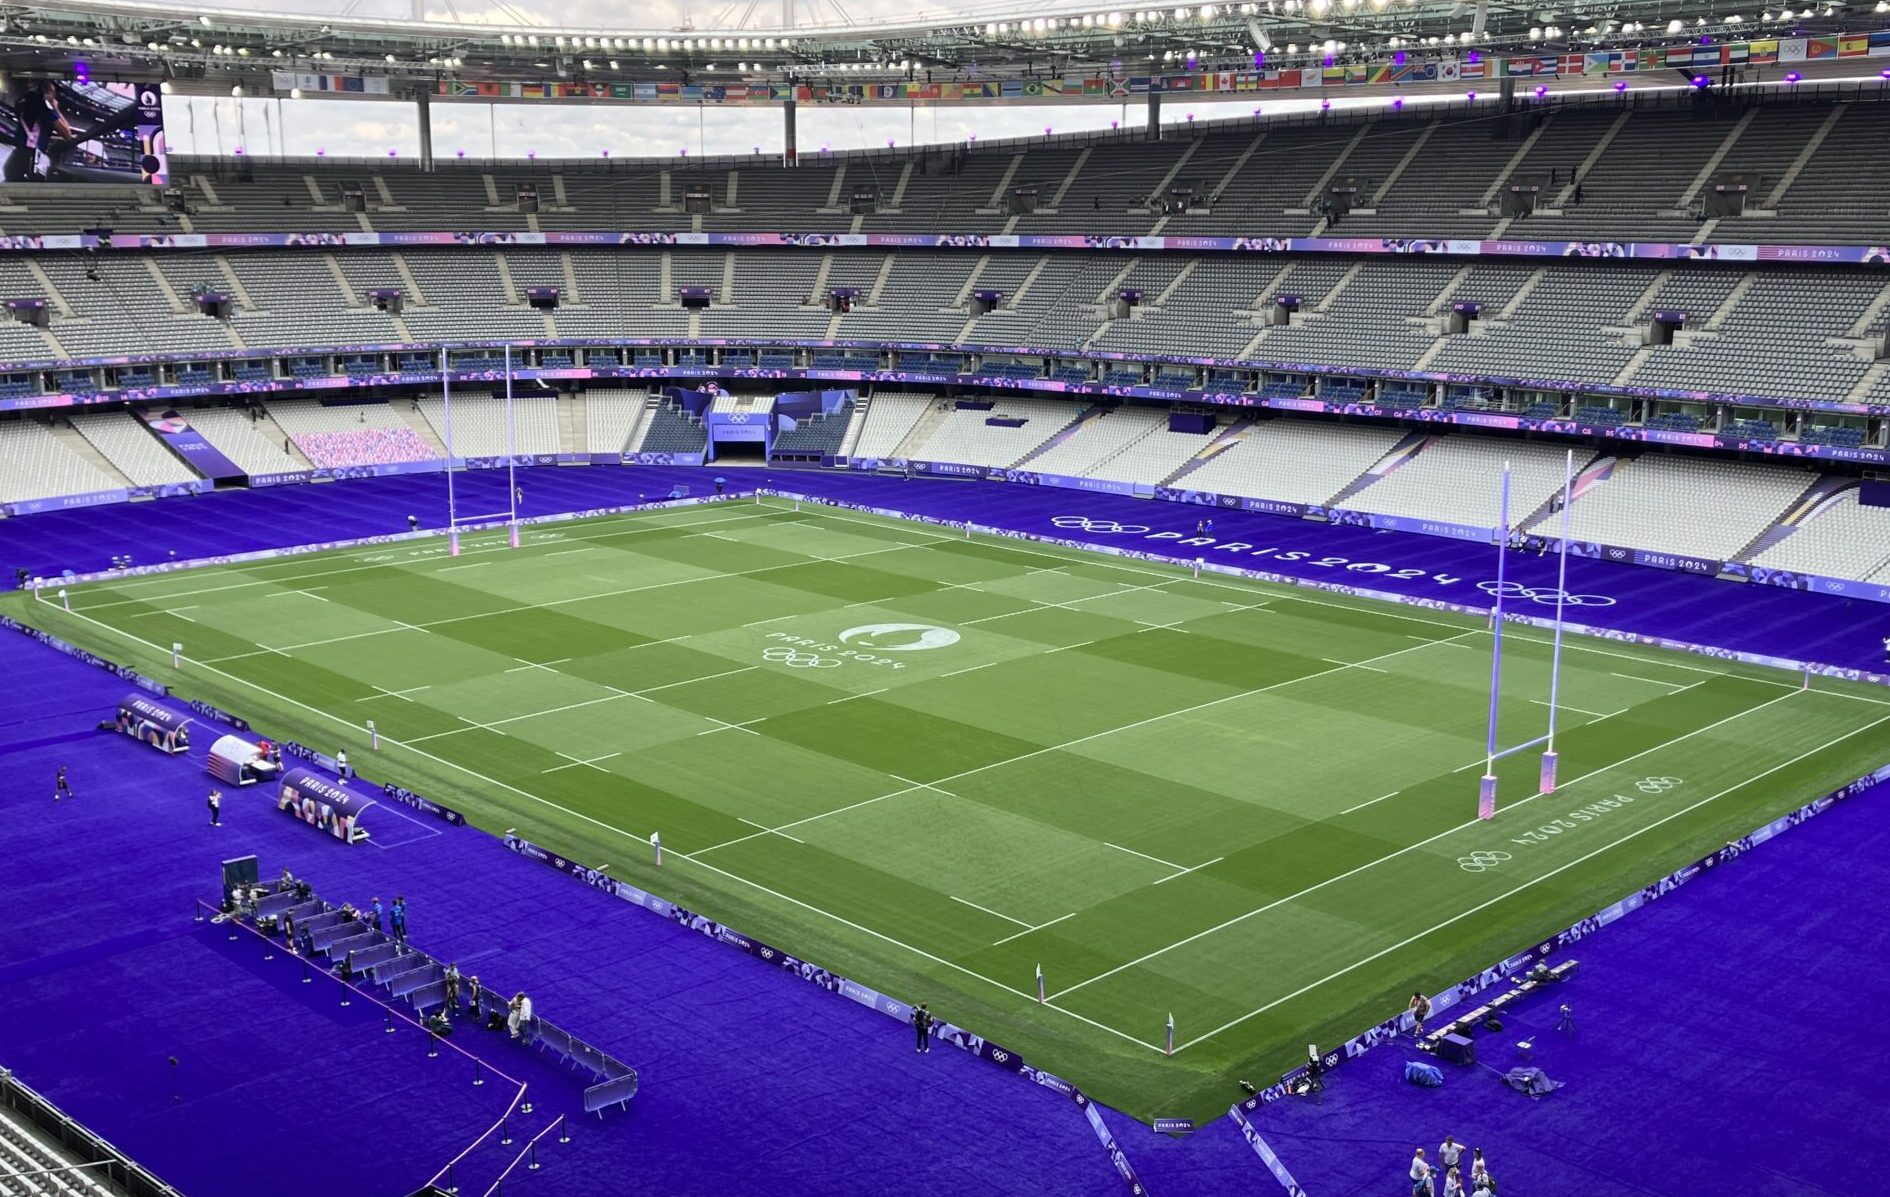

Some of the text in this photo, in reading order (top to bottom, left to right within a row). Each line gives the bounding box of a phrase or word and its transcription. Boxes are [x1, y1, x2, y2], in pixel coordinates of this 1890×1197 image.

[1466, 415, 1488, 423] PARIS
[1656, 433, 1703, 444] PARIS 2024
[1832, 449, 1885, 461] PARIS 2024
[939, 464, 980, 475] PARIS 2024
[255, 473, 306, 484] PARIS 2024
[1080, 480, 1122, 491] PARIS 2024
[64, 494, 117, 505] PARIS 2024
[1249, 501, 1297, 514] PARIS 2024
[1422, 523, 1477, 537] PARIS 2024
[1144, 531, 1461, 585] PARIS 2024
[1645, 554, 1708, 571] PARIS 2024
[765, 632, 907, 670] PARIS 2024
[131, 700, 173, 723] PARIS 2024
[299, 776, 350, 805] PARIS 2024
[1511, 794, 1635, 846] PARIS 2024
